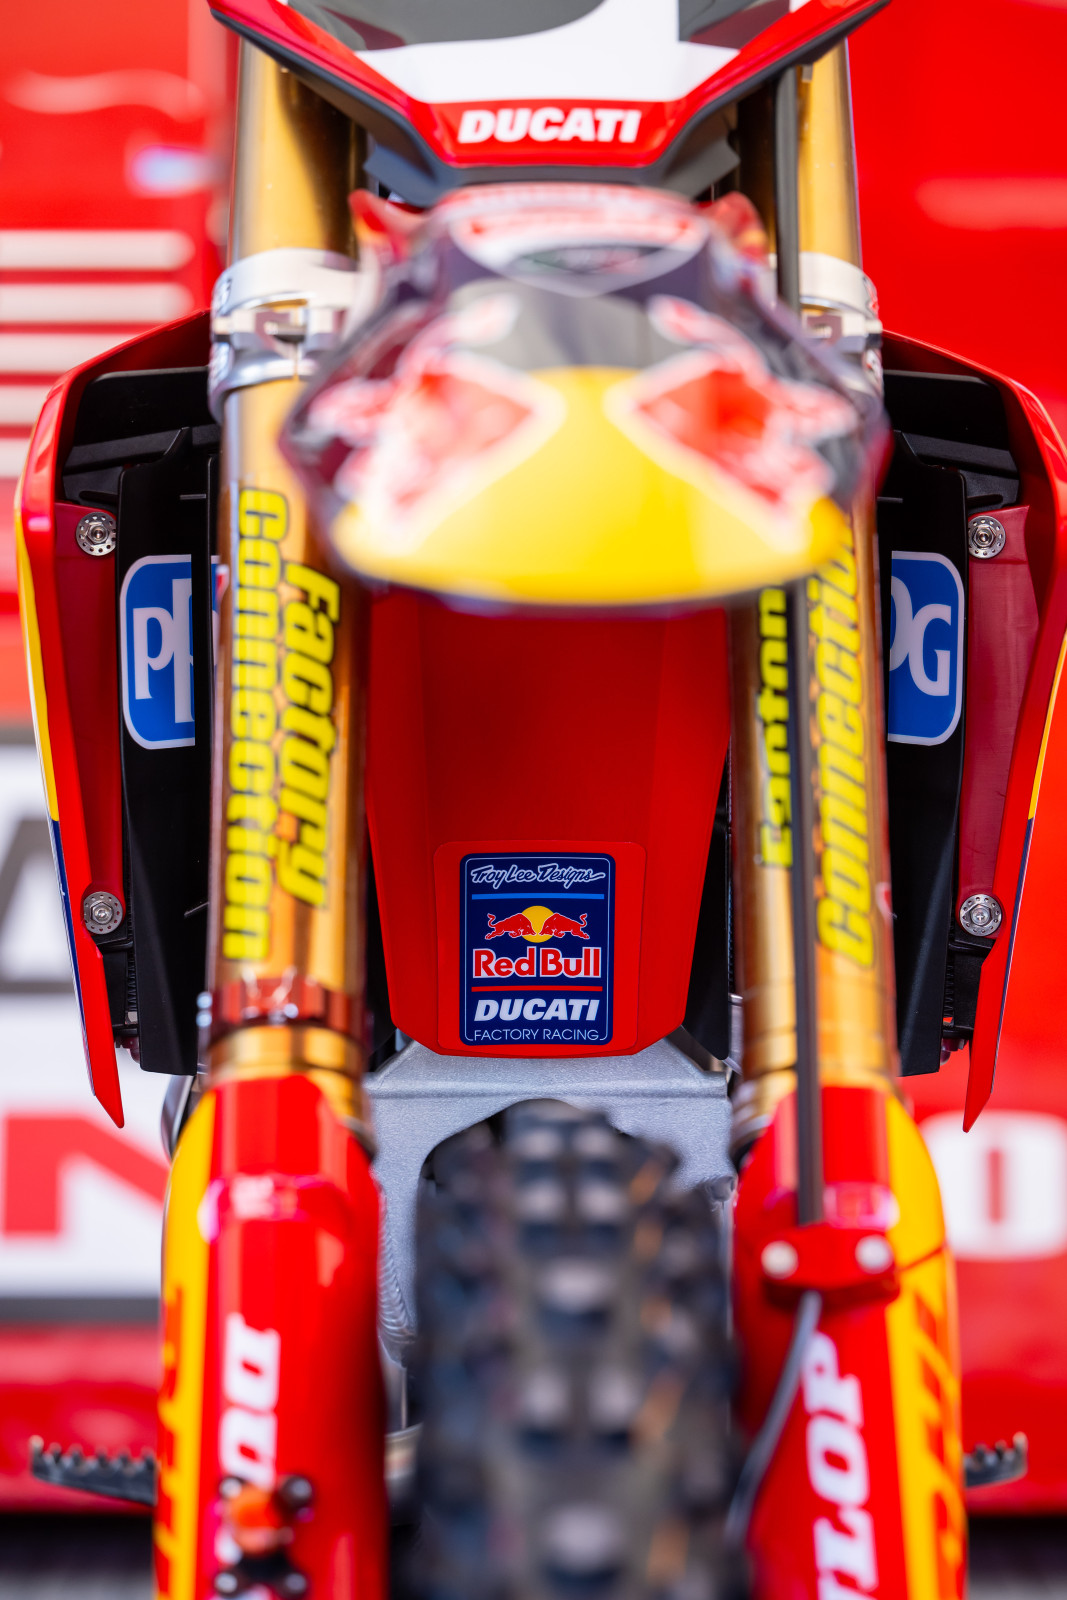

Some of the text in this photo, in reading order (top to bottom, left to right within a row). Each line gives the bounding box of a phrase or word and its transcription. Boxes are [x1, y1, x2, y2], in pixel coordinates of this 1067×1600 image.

[457, 106, 642, 144] DUCATI
[222, 487, 289, 960] Connection
[276, 561, 341, 908] Factory
[470, 863, 606, 889] Troy Lee Designs
[472, 946, 602, 979] Red Bull
[474, 998, 600, 1022] DUCATI
[474, 1029, 599, 1041] FACTORY RACING
